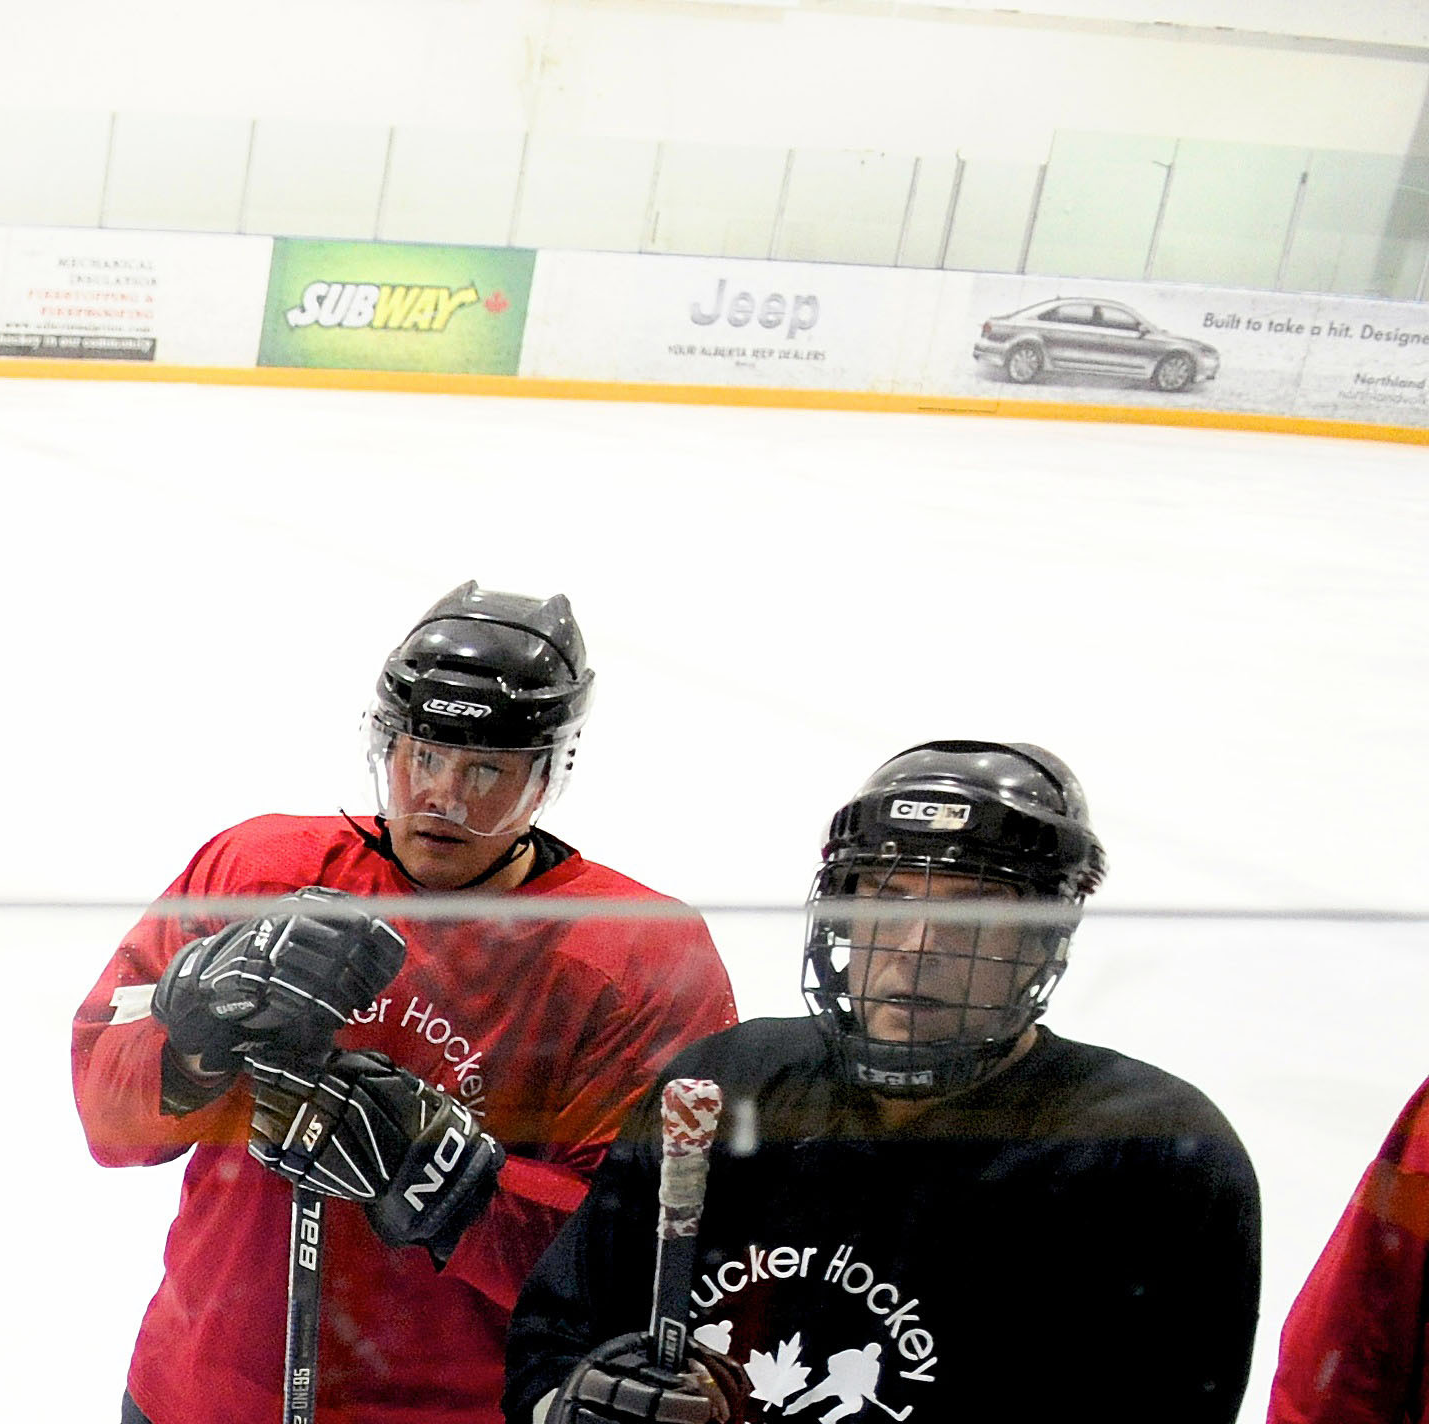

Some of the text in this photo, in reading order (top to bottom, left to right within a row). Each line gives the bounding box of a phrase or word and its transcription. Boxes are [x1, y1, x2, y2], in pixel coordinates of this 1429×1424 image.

[286, 280, 480, 332] SUBWAY
[689, 276, 821, 341] Jeep
[1203, 311, 1429, 348] Built to take a hit. Designe
[430, 699, 484, 718] CCM
[897, 803, 965, 821] CCM
[689, 1244, 938, 1383] ucker Hockey
[293, 1368, 311, 1410] ONE95
